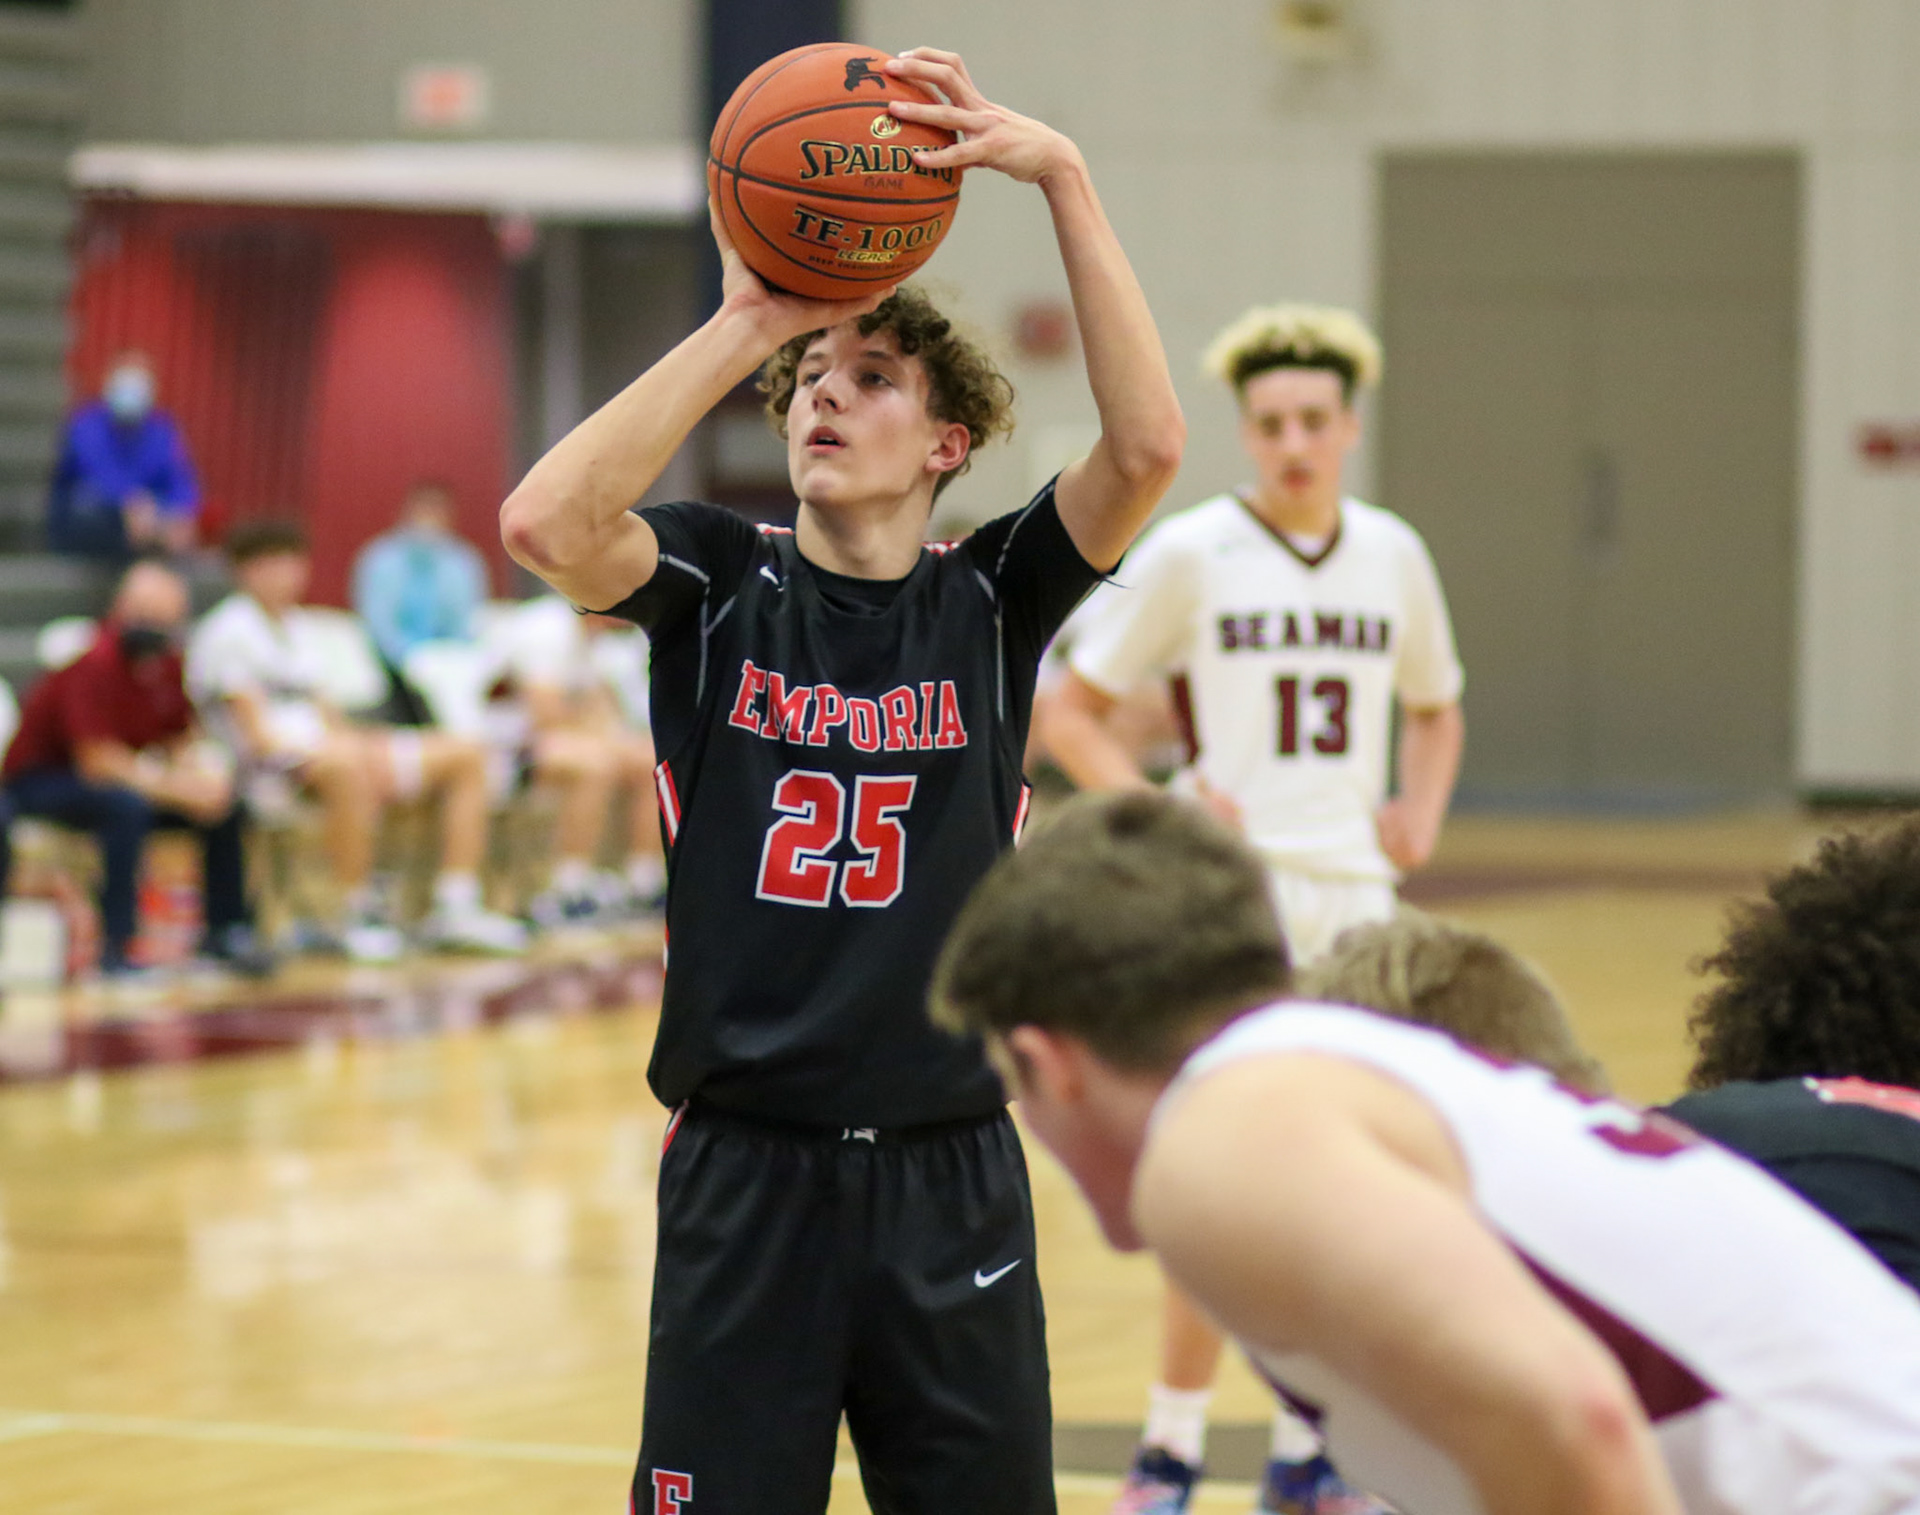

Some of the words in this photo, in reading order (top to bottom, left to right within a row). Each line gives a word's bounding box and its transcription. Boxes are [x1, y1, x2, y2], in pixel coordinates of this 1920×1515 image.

[793, 207, 942, 250] TF-1000
[728, 659, 968, 752] EMPORIA
[1276, 677, 1349, 755] 13
[755, 769, 917, 907] 25
